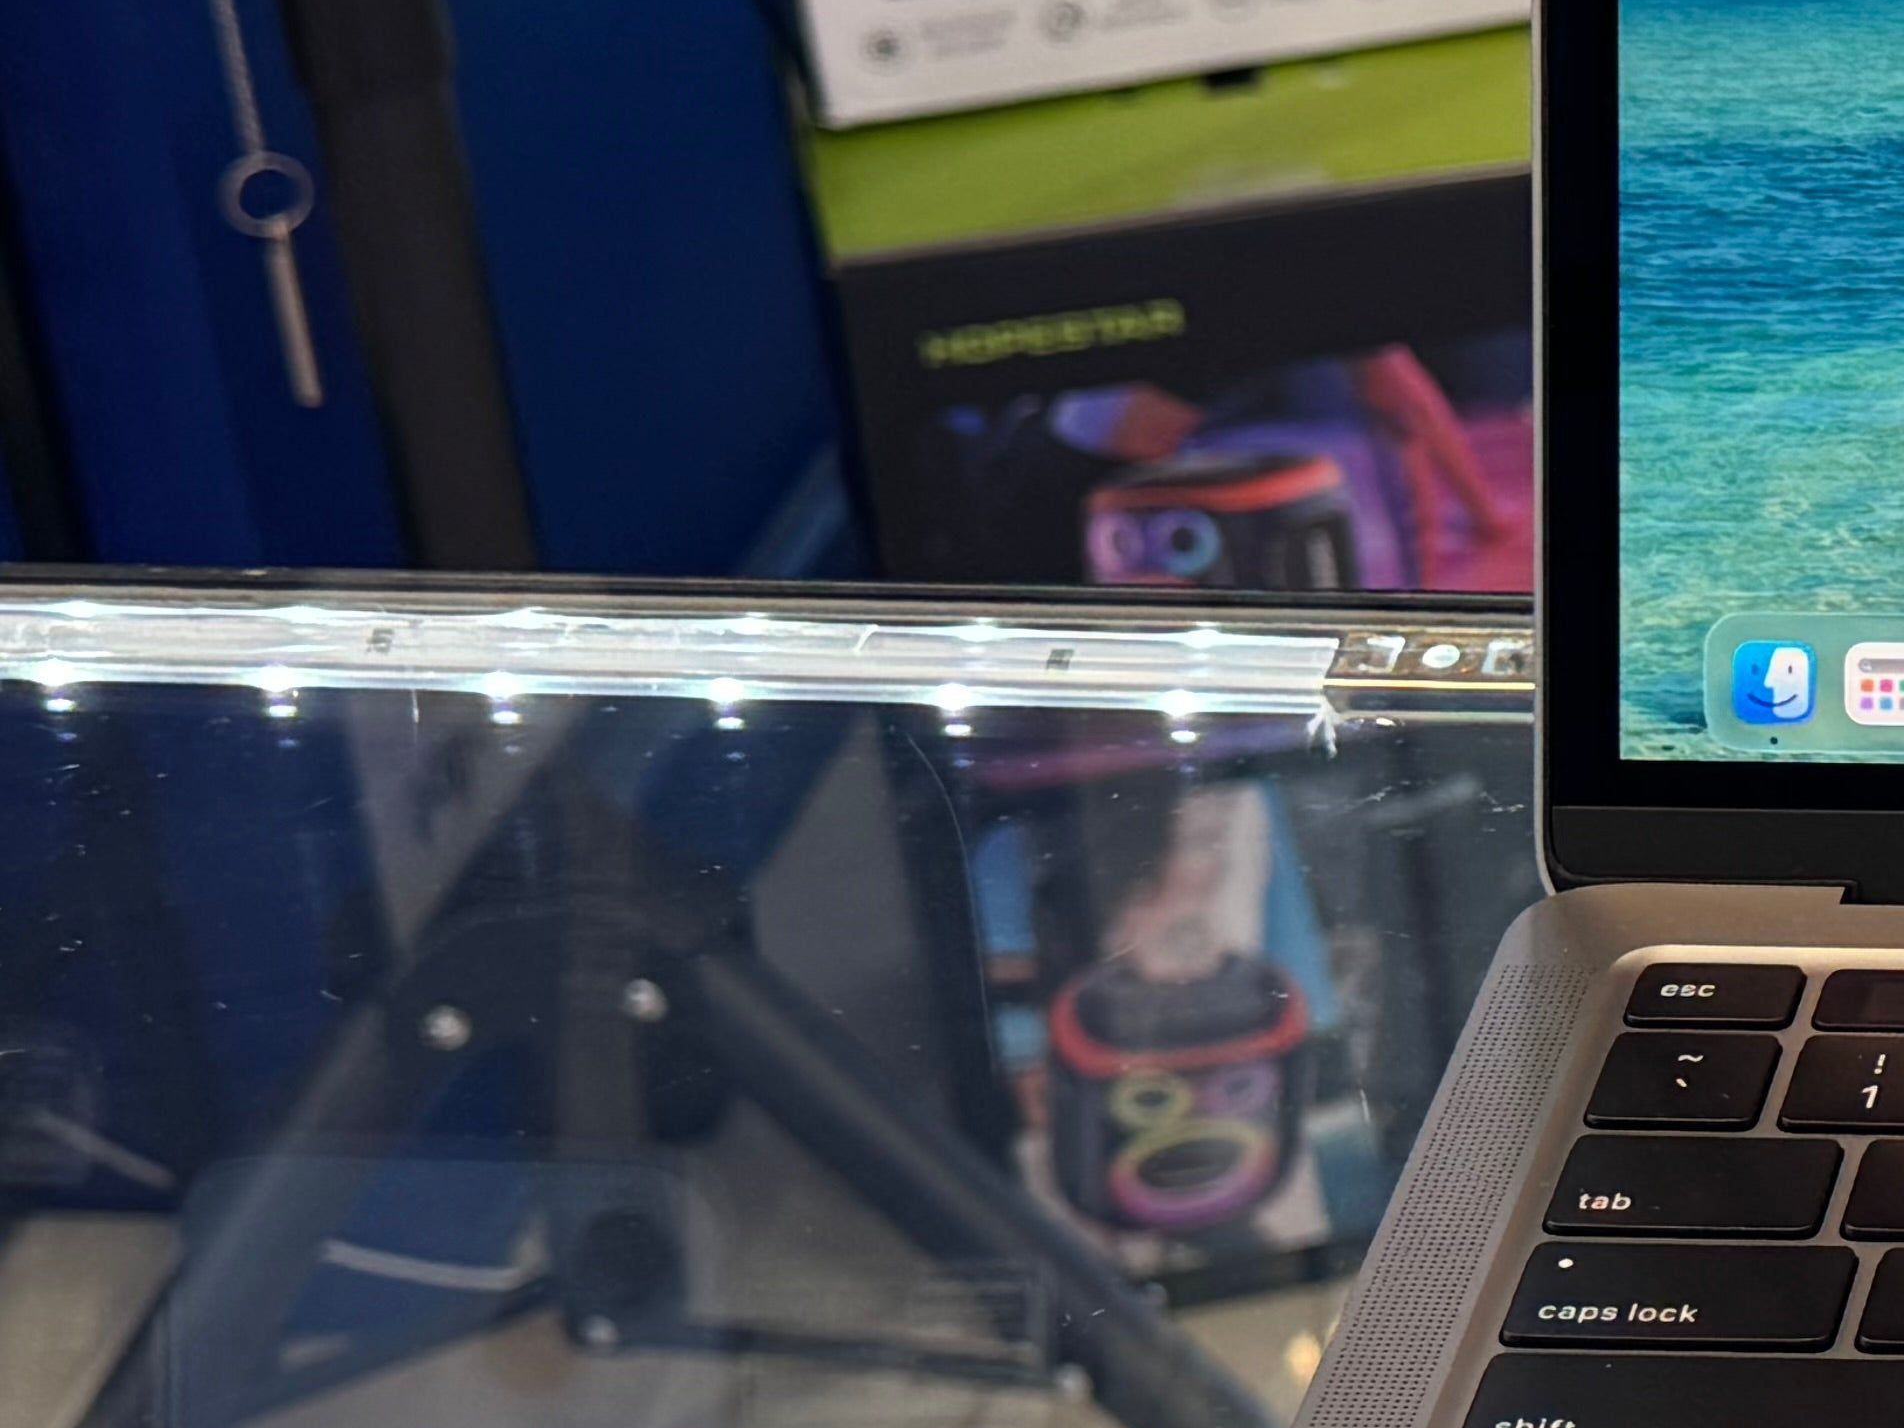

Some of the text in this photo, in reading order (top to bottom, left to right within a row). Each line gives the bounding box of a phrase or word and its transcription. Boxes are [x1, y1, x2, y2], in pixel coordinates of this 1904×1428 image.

[1660, 984, 1716, 998] esc
[1862, 1085, 1879, 1109] 1
[1579, 1192, 1632, 1210] tab
[1538, 1305, 1618, 1324] caps
[1628, 1303, 1698, 1323] lock
